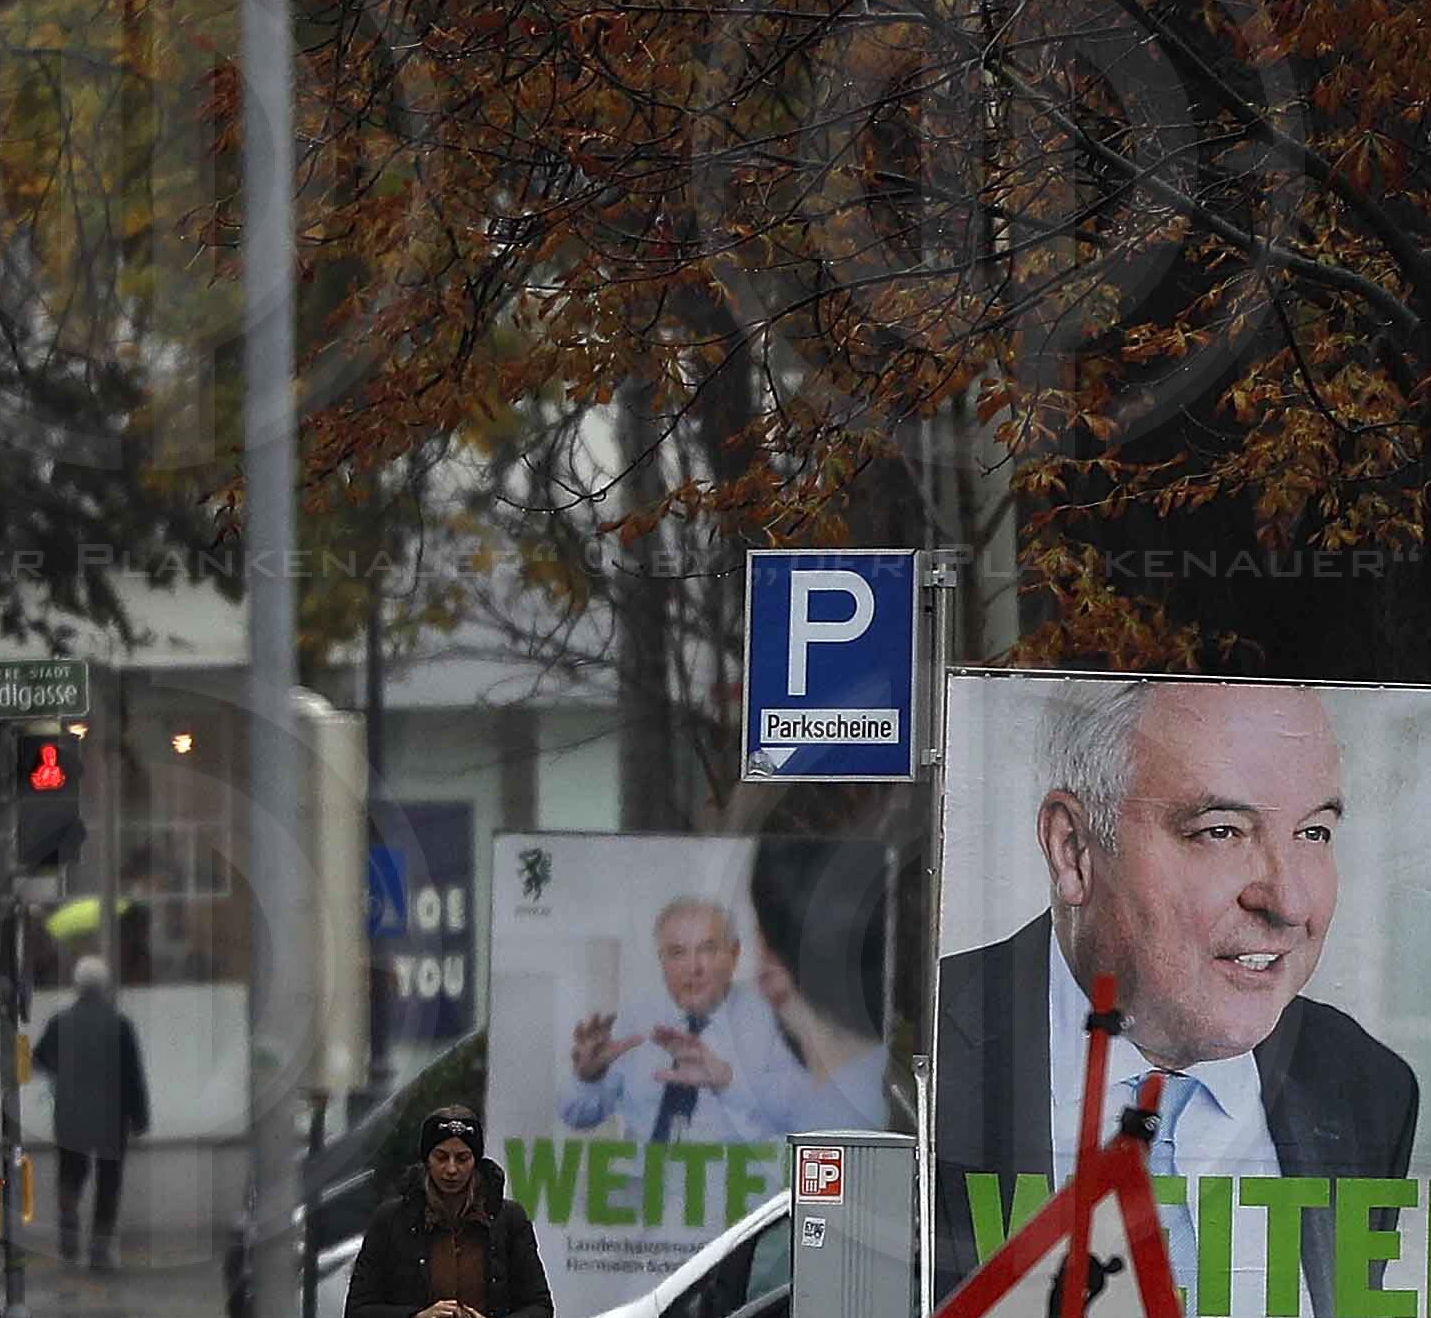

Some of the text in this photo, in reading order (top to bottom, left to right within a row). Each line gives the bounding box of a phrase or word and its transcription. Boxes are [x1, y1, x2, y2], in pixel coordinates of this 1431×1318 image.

[788, 570, 874, 695] P
[30, 666, 71, 680] STADT
[768, 714, 892, 738] Parkscheine
[504, 1137, 791, 1229] WEITE
